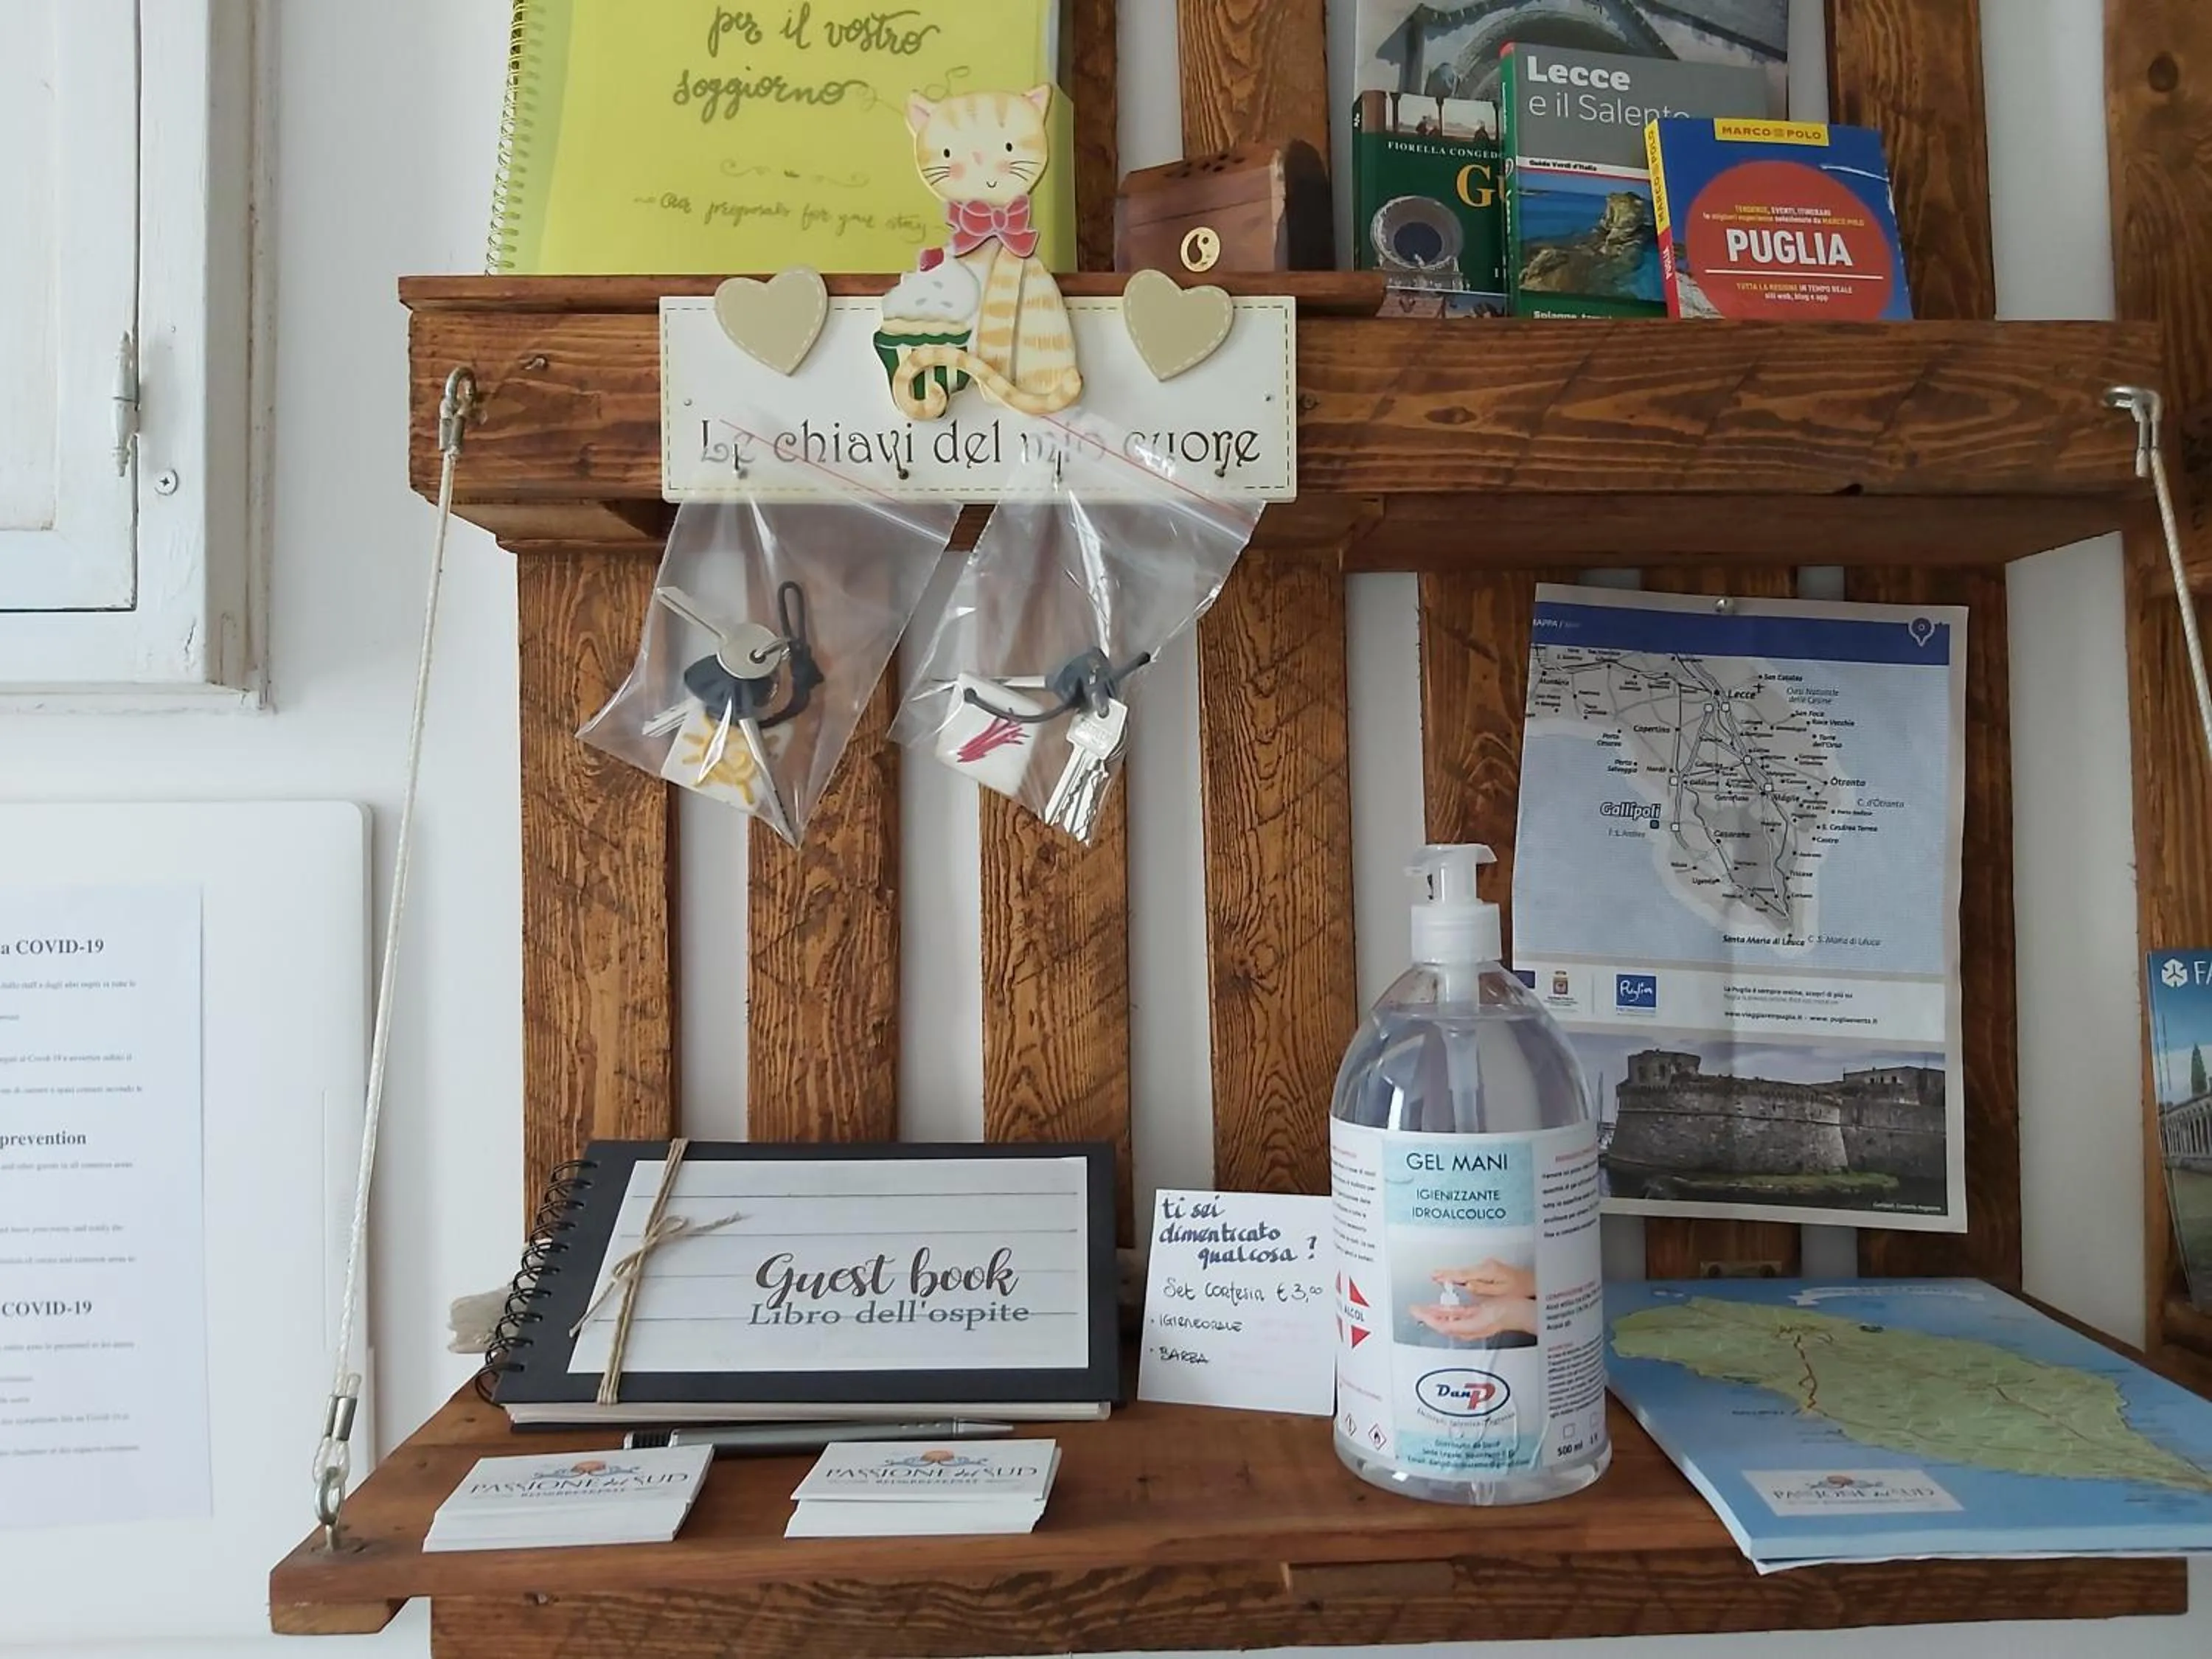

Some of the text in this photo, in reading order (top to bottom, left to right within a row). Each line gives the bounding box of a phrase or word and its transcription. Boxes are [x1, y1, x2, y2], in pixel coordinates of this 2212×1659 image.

[708, 4, 941, 58] per il vostro
[1526, 55, 1631, 91] Lecce
[672, 67, 870, 124] soggiorno
[1528, 92, 1690, 126] e il Salent
[1722, 126, 1821, 139] MARCO POLO
[1388, 141, 1446, 156] FIORELLA
[1726, 228, 1854, 267] PUGLIA
[774, 418, 914, 465] chiavi
[933, 418, 1001, 469] del
[1728, 689, 1756, 700] Lecce
[15, 939, 104, 955] COVID-19
[1620, 980, 1652, 1001] Puglia
[0, 1130, 87, 1150] prevention
[1406, 1152, 1508, 1172] GEL MANI
[1416, 1189, 1500, 1201] IGIENIZZANTE
[1162, 1195, 1225, 1219] ti sei
[1412, 1207, 1506, 1220] IDROALCOLICO
[1158, 1221, 1281, 1243] dimenticato
[1197, 1246, 1298, 1270] qualcosa
[755, 1247, 1020, 1310] Guest book
[1163, 1276, 1196, 1300] Set
[1, 1301, 93, 1318] COVID-19
[749, 1299, 1030, 1331] Libro dell'ospite
[825, 1466, 950, 1478] PASSIONE
[982, 1466, 1037, 1477] SUD
[470, 1475, 602, 1495] PASSIONE
[633, 1472, 689, 1486] SUD
